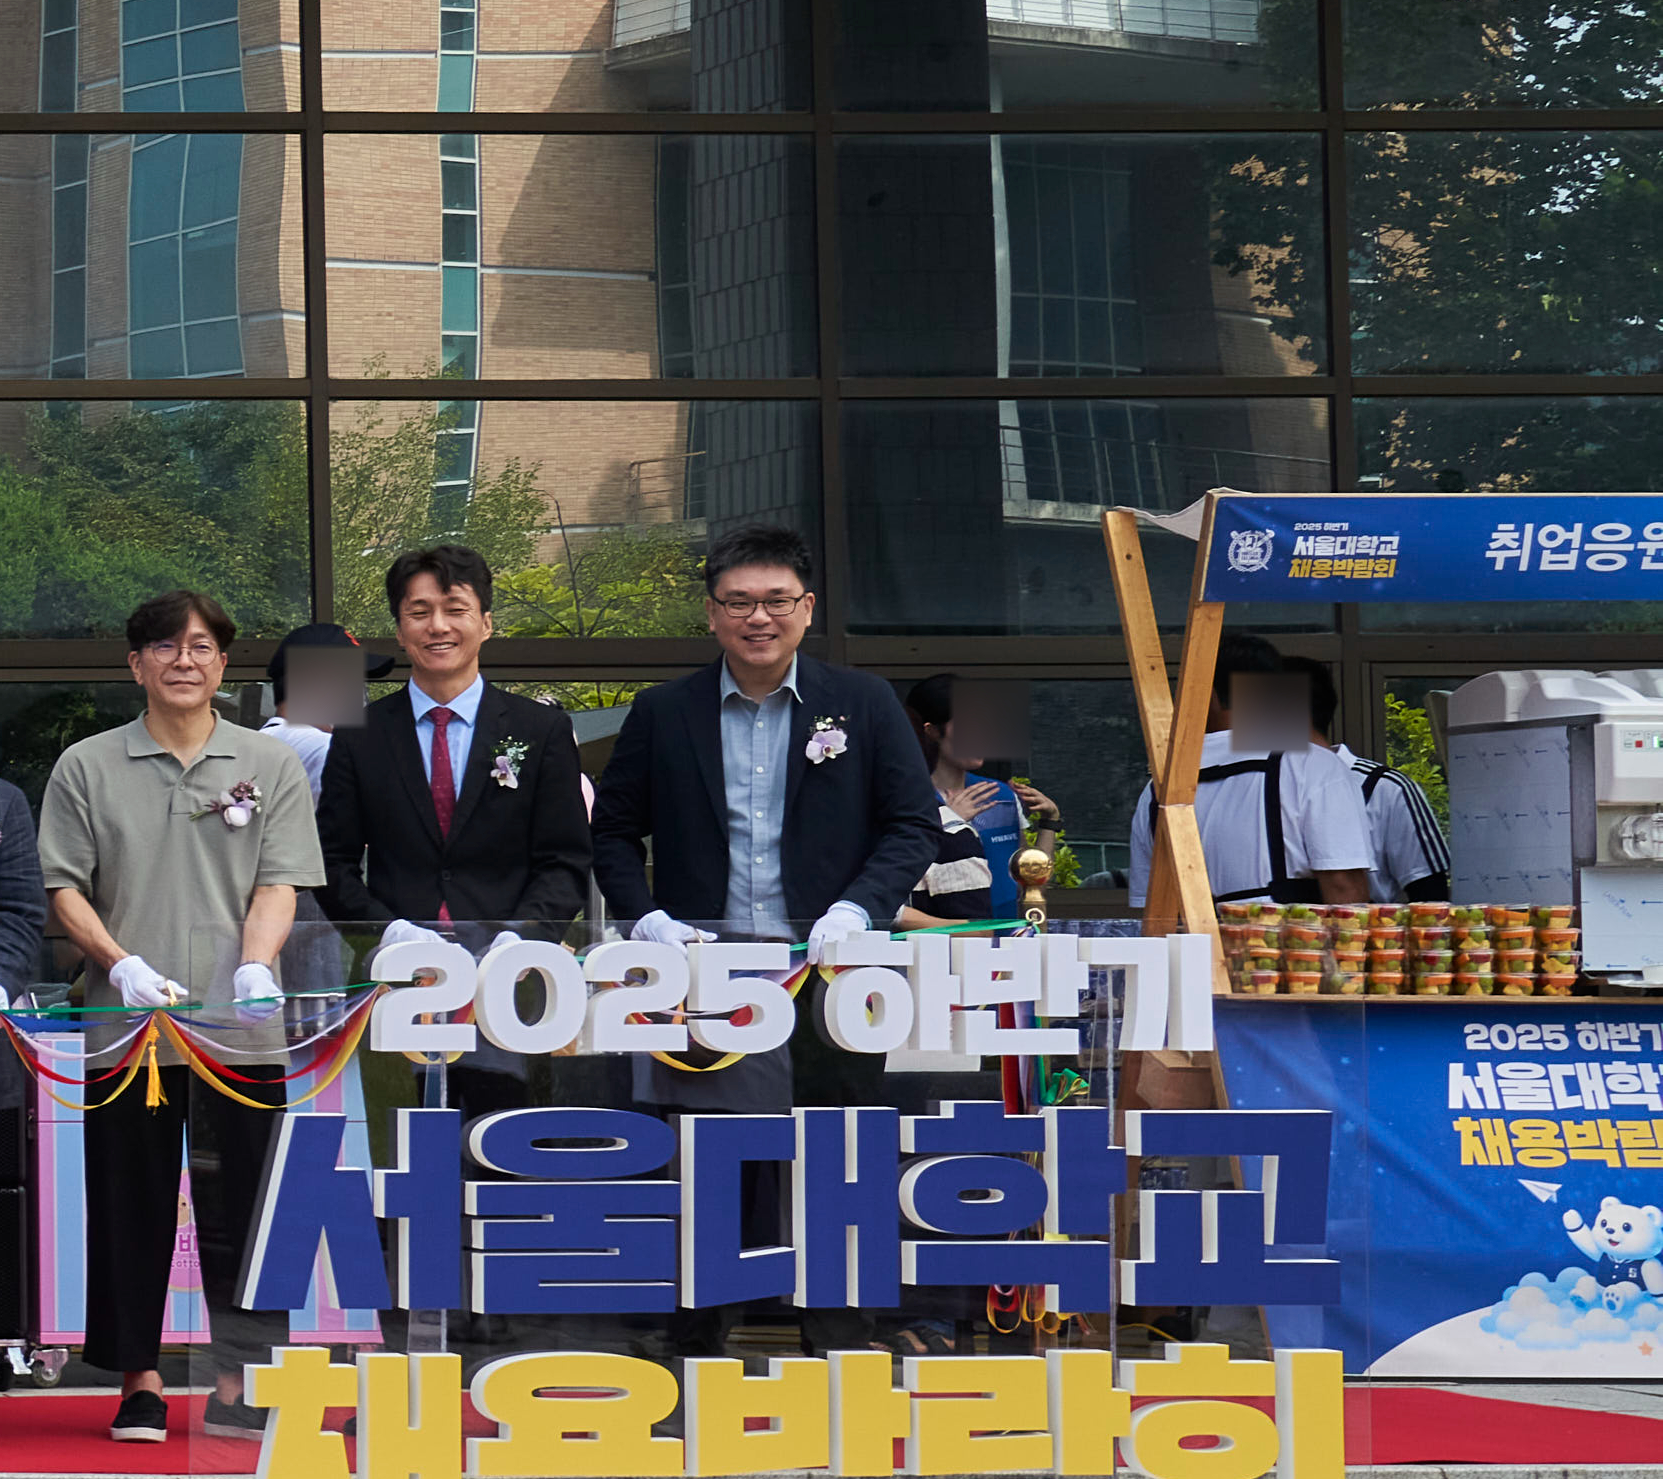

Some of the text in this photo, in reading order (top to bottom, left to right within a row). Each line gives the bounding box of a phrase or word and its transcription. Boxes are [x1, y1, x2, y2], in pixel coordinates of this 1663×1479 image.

[1294, 522, 1322, 531] 2025
[1292, 535, 1400, 556] 서울대학교
[1288, 558, 1397, 579] 채용박람회
[371, 929, 1214, 1056] 2025 하반기
[1463, 1023, 1570, 1051] 2025
[240, 1100, 1341, 1314] 서울대학교
